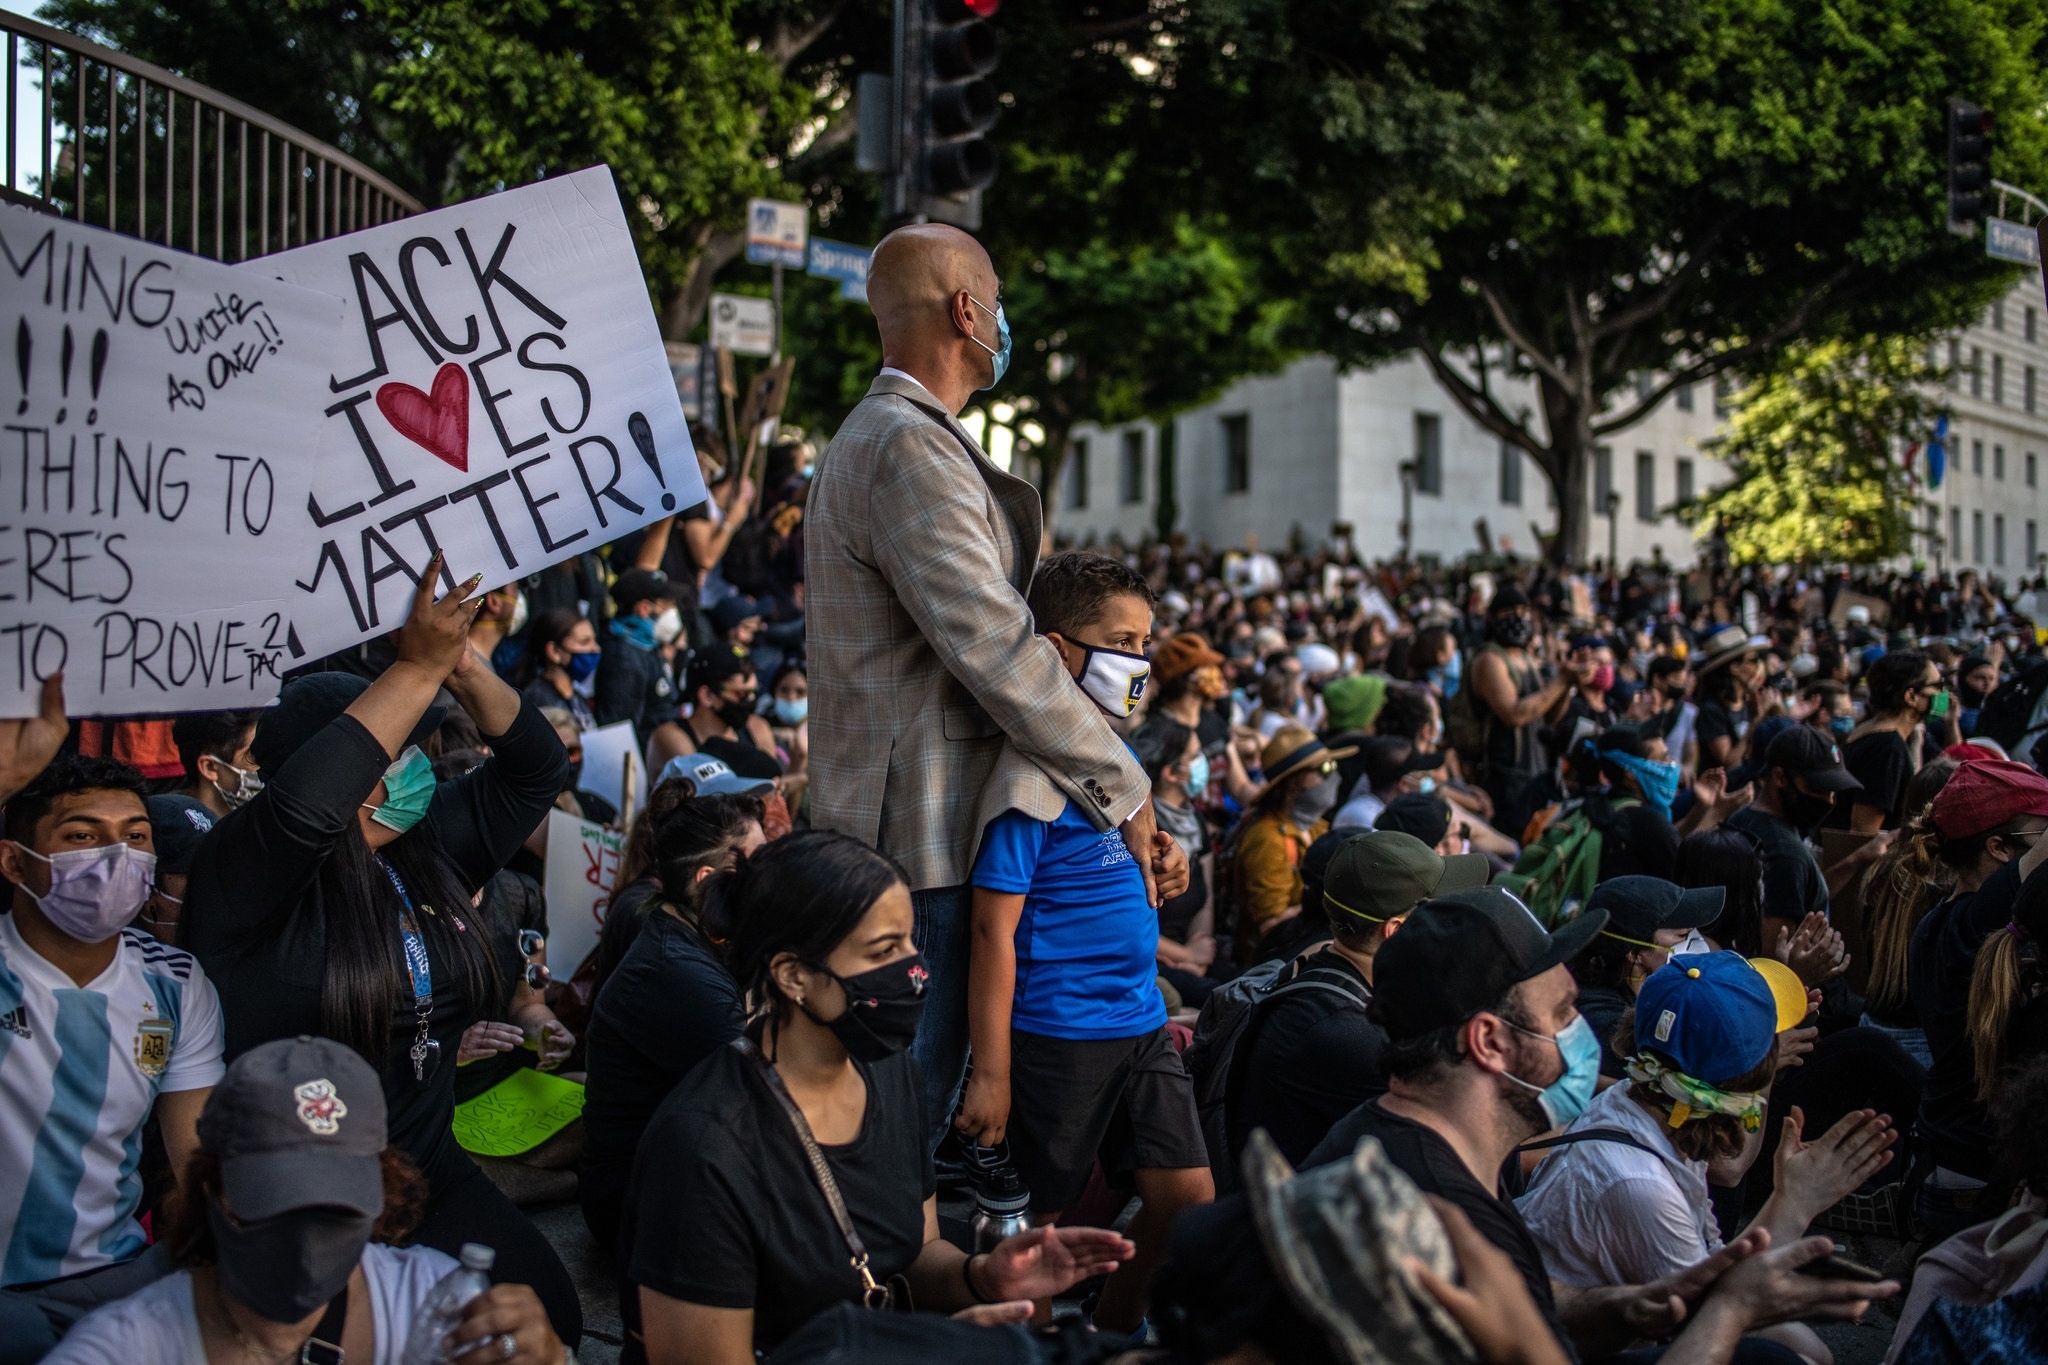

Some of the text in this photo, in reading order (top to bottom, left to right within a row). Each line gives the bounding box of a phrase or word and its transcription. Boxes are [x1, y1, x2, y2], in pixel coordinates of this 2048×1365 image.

[329, 222, 568, 393] ACK
[214, 452, 275, 537] TO
[287, 411, 677, 659] MATTER!
[698, 763, 716, 779] NO
